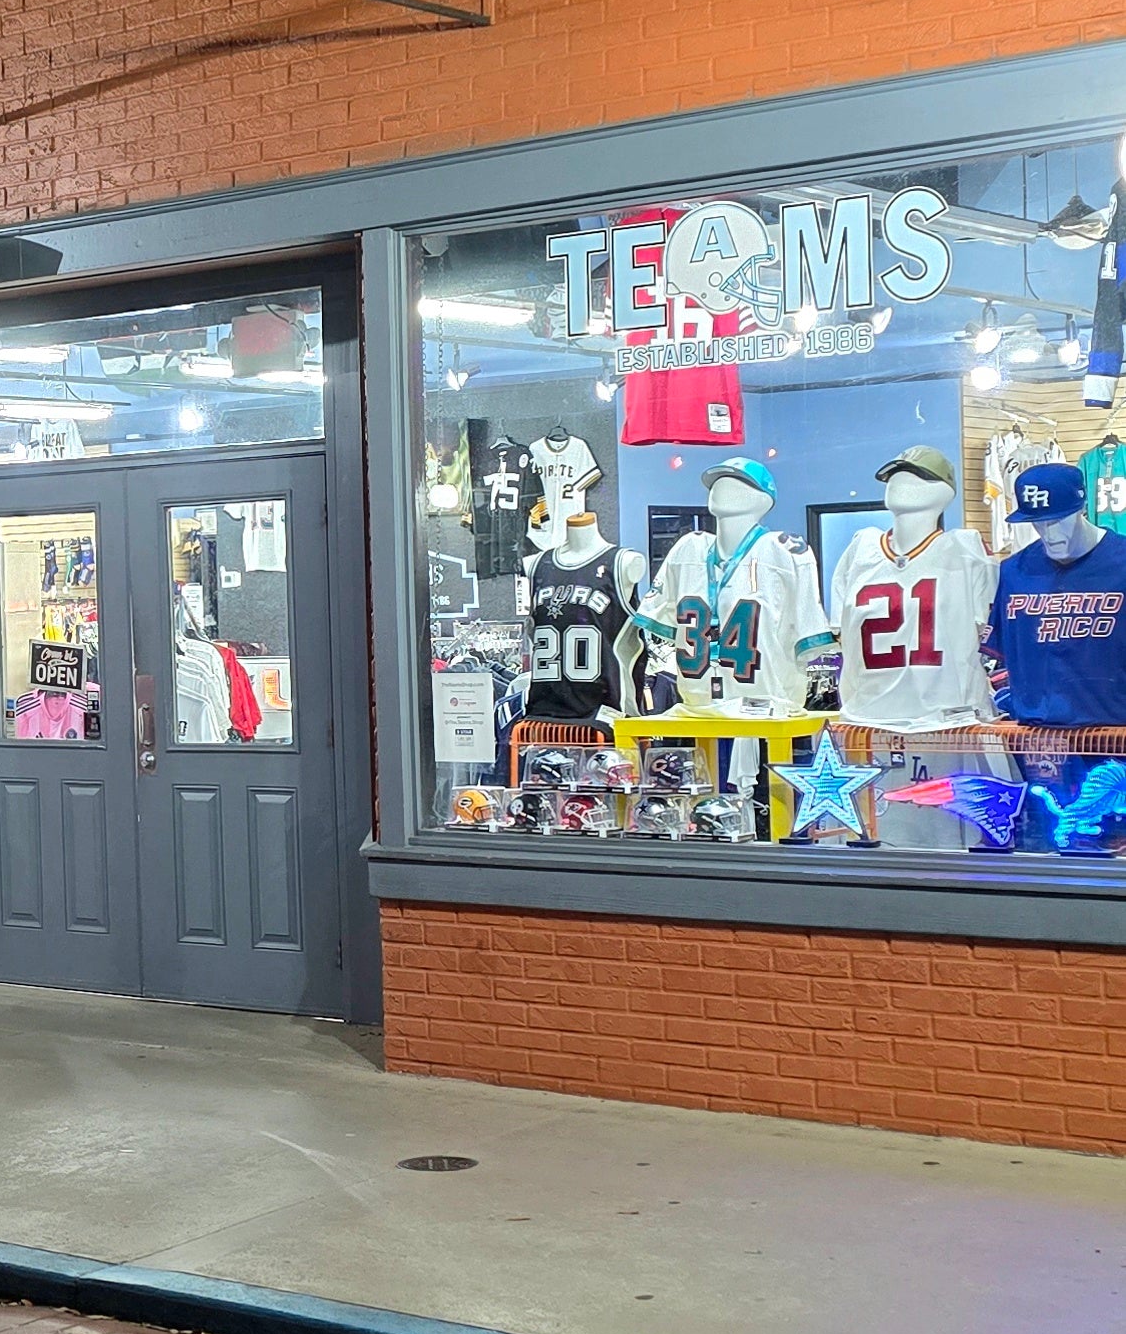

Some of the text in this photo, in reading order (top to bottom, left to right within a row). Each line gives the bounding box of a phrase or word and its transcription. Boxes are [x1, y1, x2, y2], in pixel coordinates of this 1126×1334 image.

[547, 185, 954, 338] TEAMS
[616, 323, 875, 375] ESTABLISHED 1986
[483, 473, 520, 511] 75
[1023, 484, 1050, 508] PR
[855, 578, 944, 669] 21
[1007, 591, 1124, 620] PUERTO
[676, 596, 761, 683] 34
[1037, 617, 1117, 643] RICO
[35, 663, 78, 687] OPEN
[532, 624, 602, 683] 20
